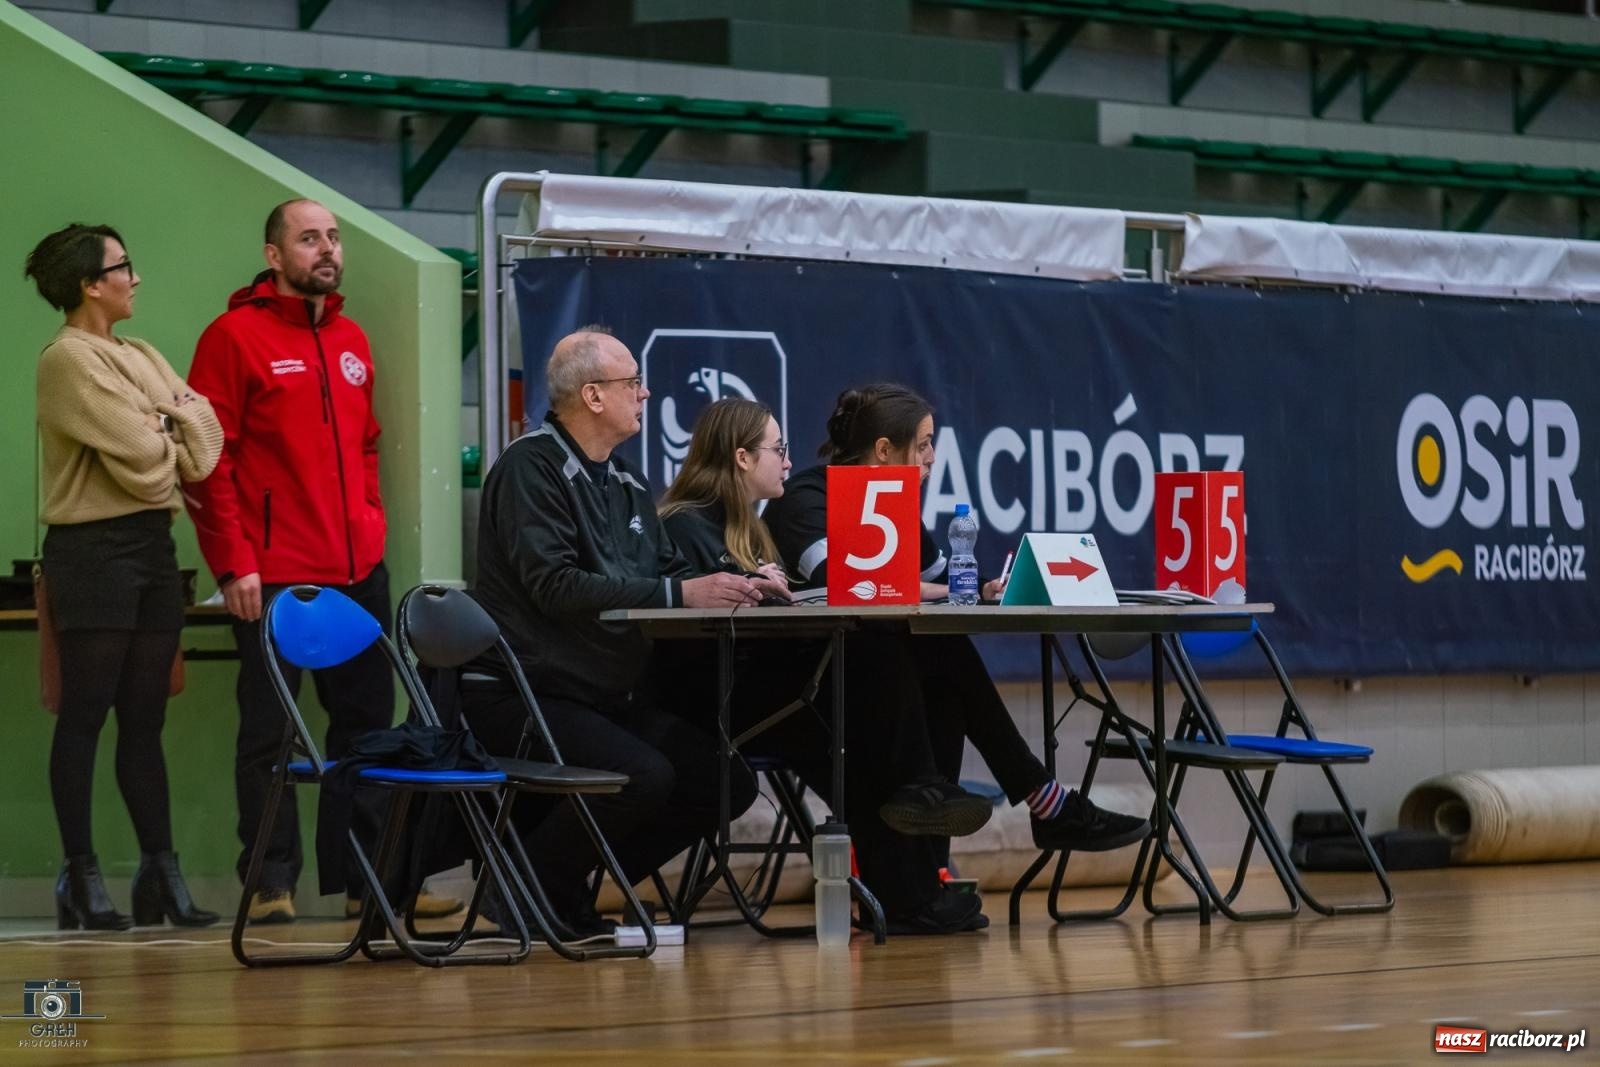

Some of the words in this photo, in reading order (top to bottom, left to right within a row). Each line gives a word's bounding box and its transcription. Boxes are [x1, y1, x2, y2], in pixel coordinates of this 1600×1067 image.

[922, 392, 1247, 536] ACIBÓ
[1397, 393, 1585, 530] OSiR
[844, 480, 904, 571] 5
[1163, 486, 1194, 572] 5
[1214, 485, 1239, 571] 5
[1475, 533, 1586, 581] RACIBÓRZ
